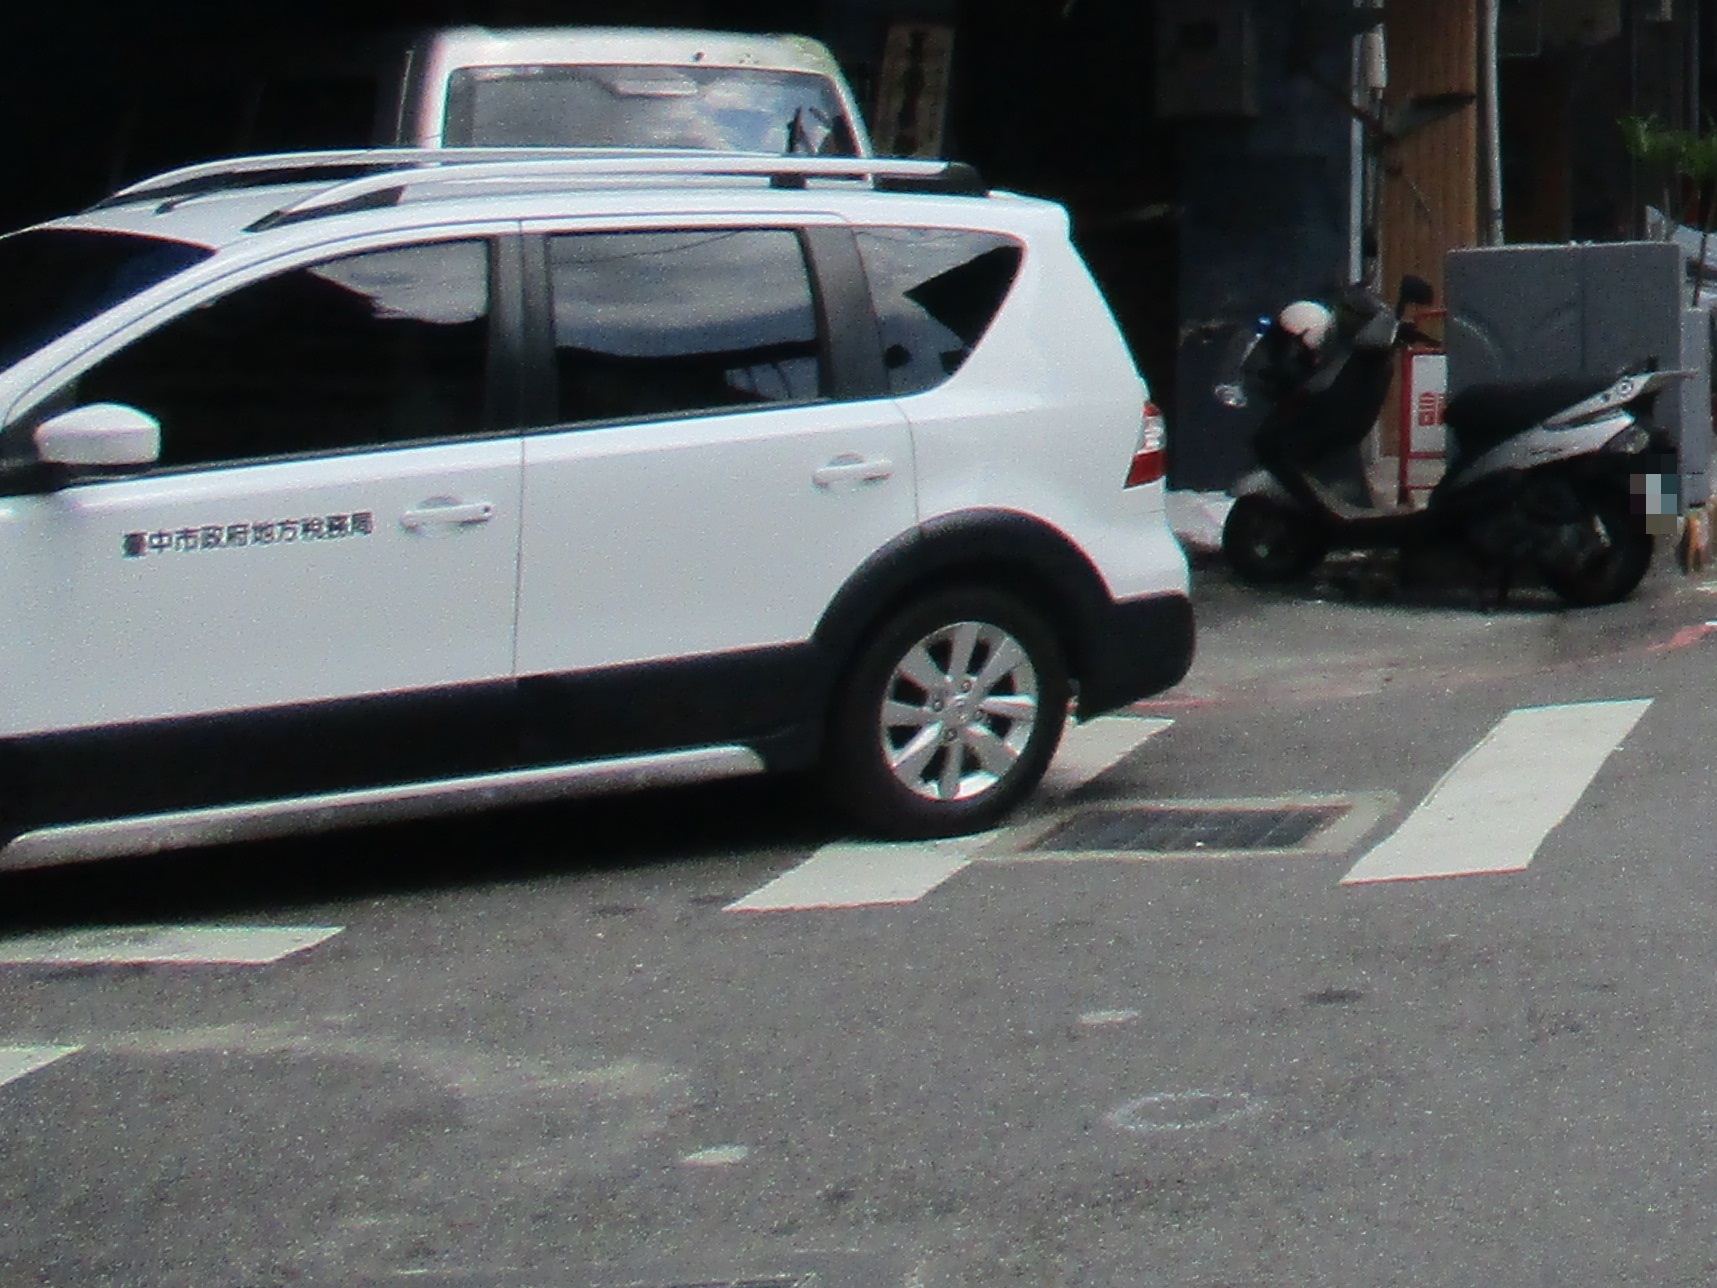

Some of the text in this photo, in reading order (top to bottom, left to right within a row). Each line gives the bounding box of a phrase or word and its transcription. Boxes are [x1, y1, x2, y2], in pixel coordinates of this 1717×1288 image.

[124, 512, 374, 558] 臺中市政府地方稅務局
